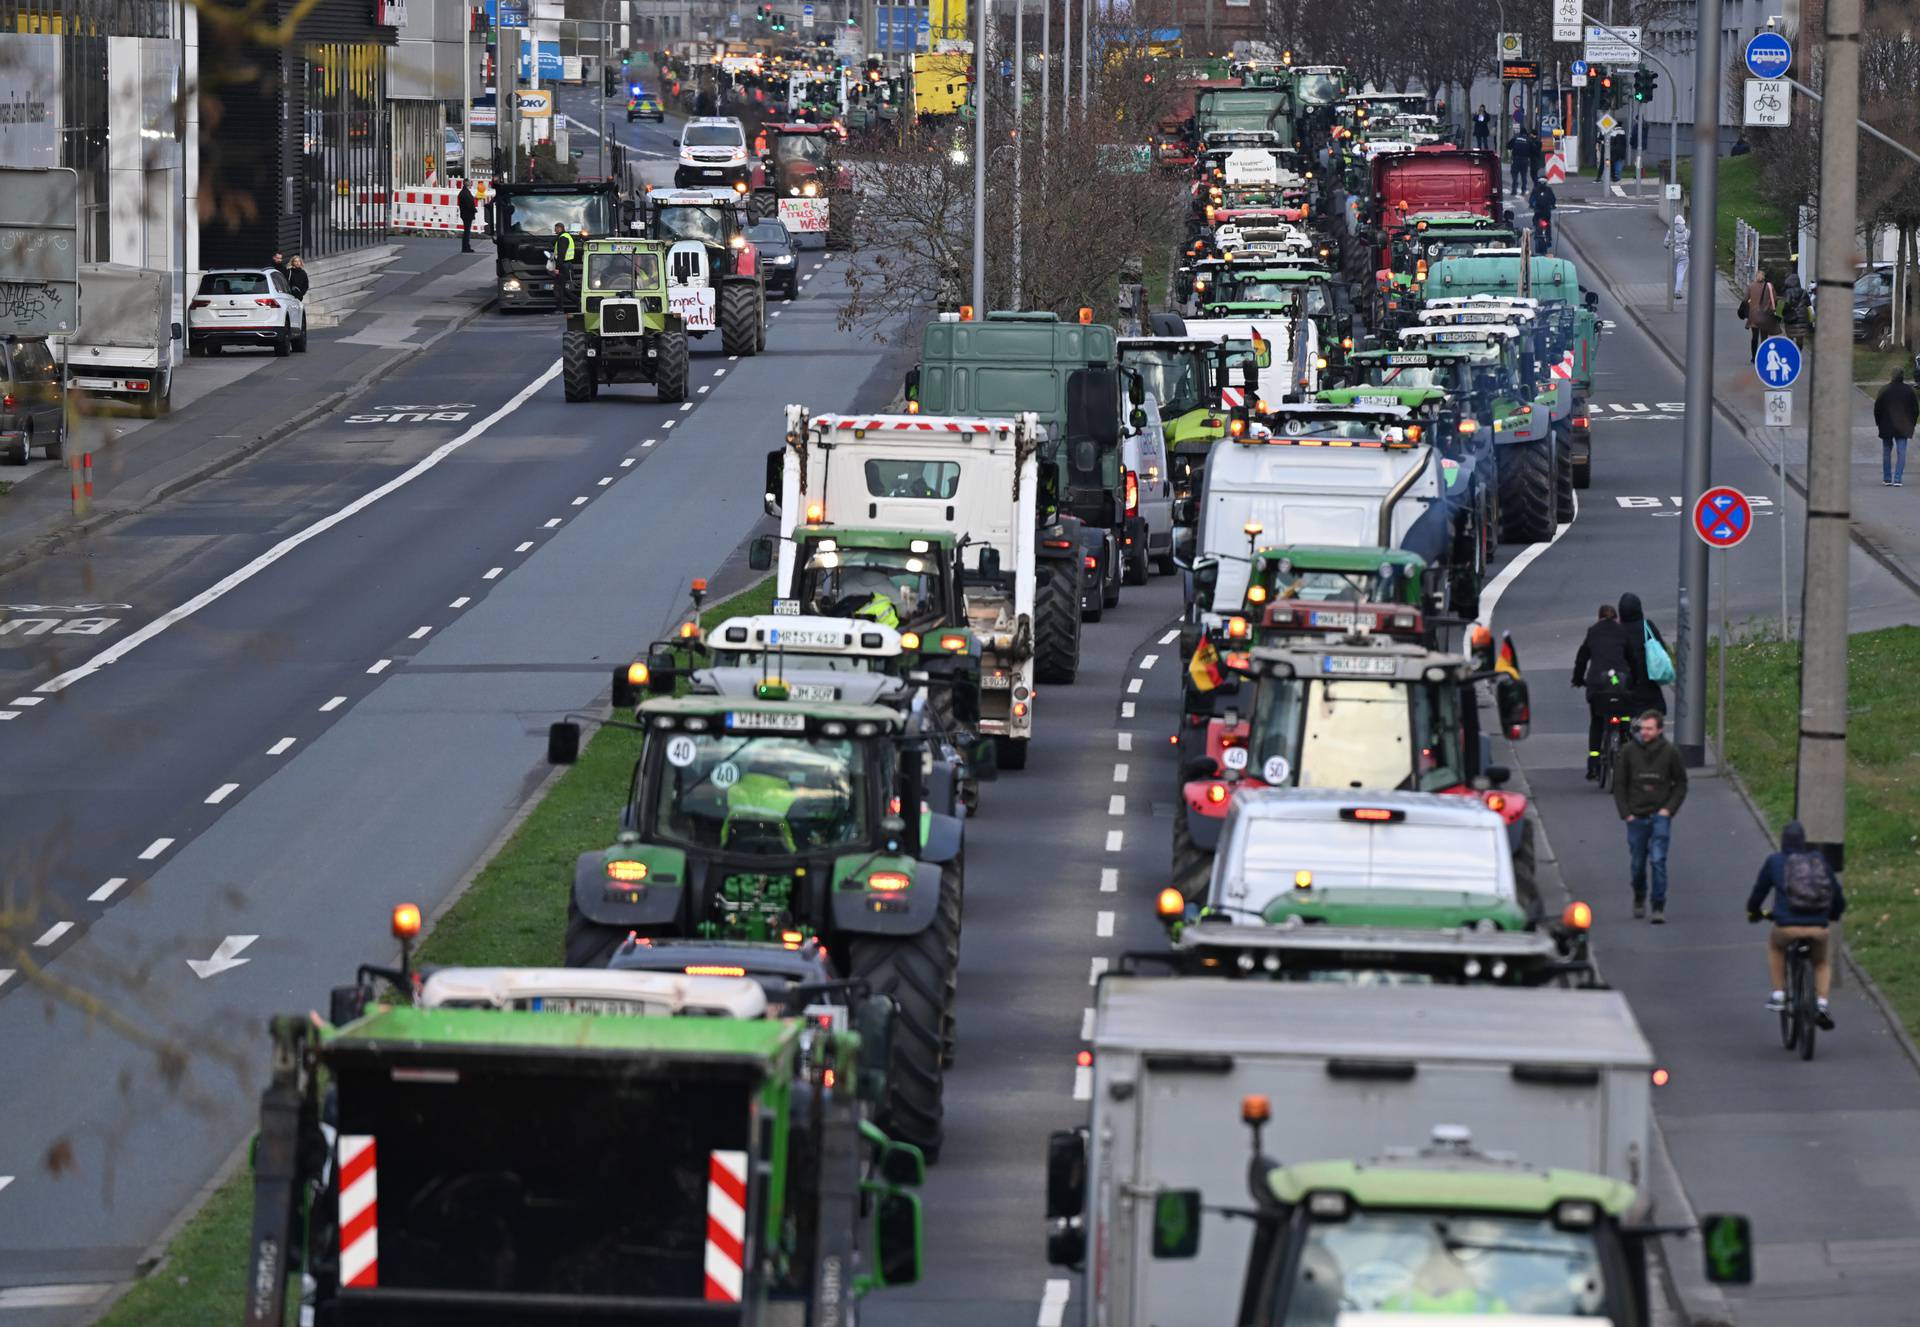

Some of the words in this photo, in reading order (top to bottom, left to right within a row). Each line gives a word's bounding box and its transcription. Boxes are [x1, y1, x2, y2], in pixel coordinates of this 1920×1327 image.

[1559, 29, 1577, 37] Ende
[1757, 82, 1781, 93] TAXI
[521, 99, 546, 108] DKV
[1759, 112, 1777, 123] frei
[780, 200, 818, 212] Amel
[669, 291, 706, 308] mpel
[344, 411, 470, 423] BUS
[1615, 496, 1774, 508] BS
[0, 617, 121, 635] BU
[777, 630, 792, 642] MR
[800, 631, 813, 643] ST
[816, 631, 838, 644] 412
[673, 742, 690, 760] 40
[1228, 751, 1245, 765] 40
[716, 766, 734, 783] 40
[1269, 761, 1284, 778] 50
